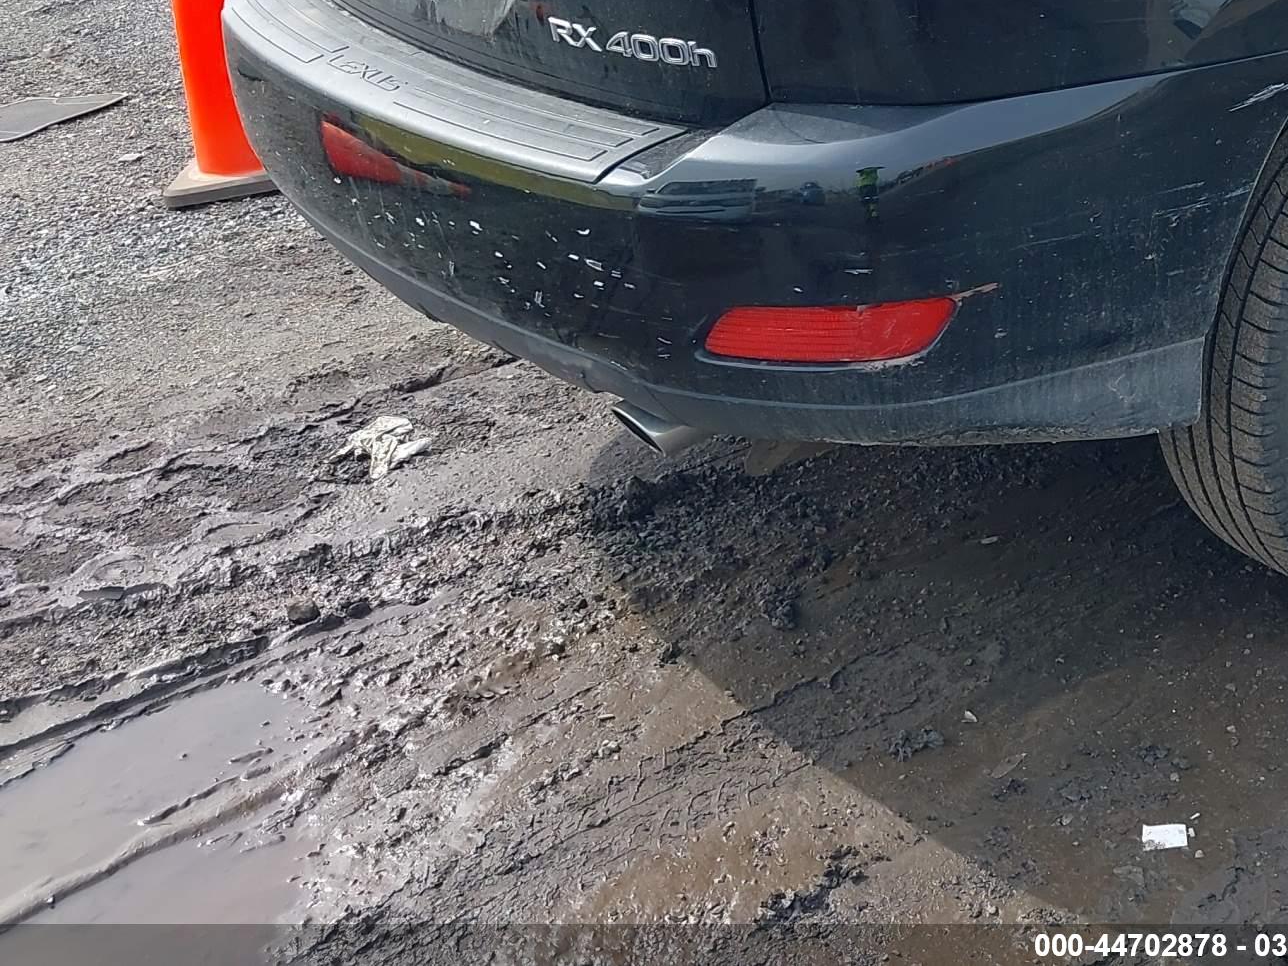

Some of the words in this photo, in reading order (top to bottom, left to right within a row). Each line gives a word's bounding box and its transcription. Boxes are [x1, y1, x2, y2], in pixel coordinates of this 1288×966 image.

[547, 16, 603, 52] RX
[606, 31, 718, 68] 400h
[326, 54, 401, 92] LEXUS
